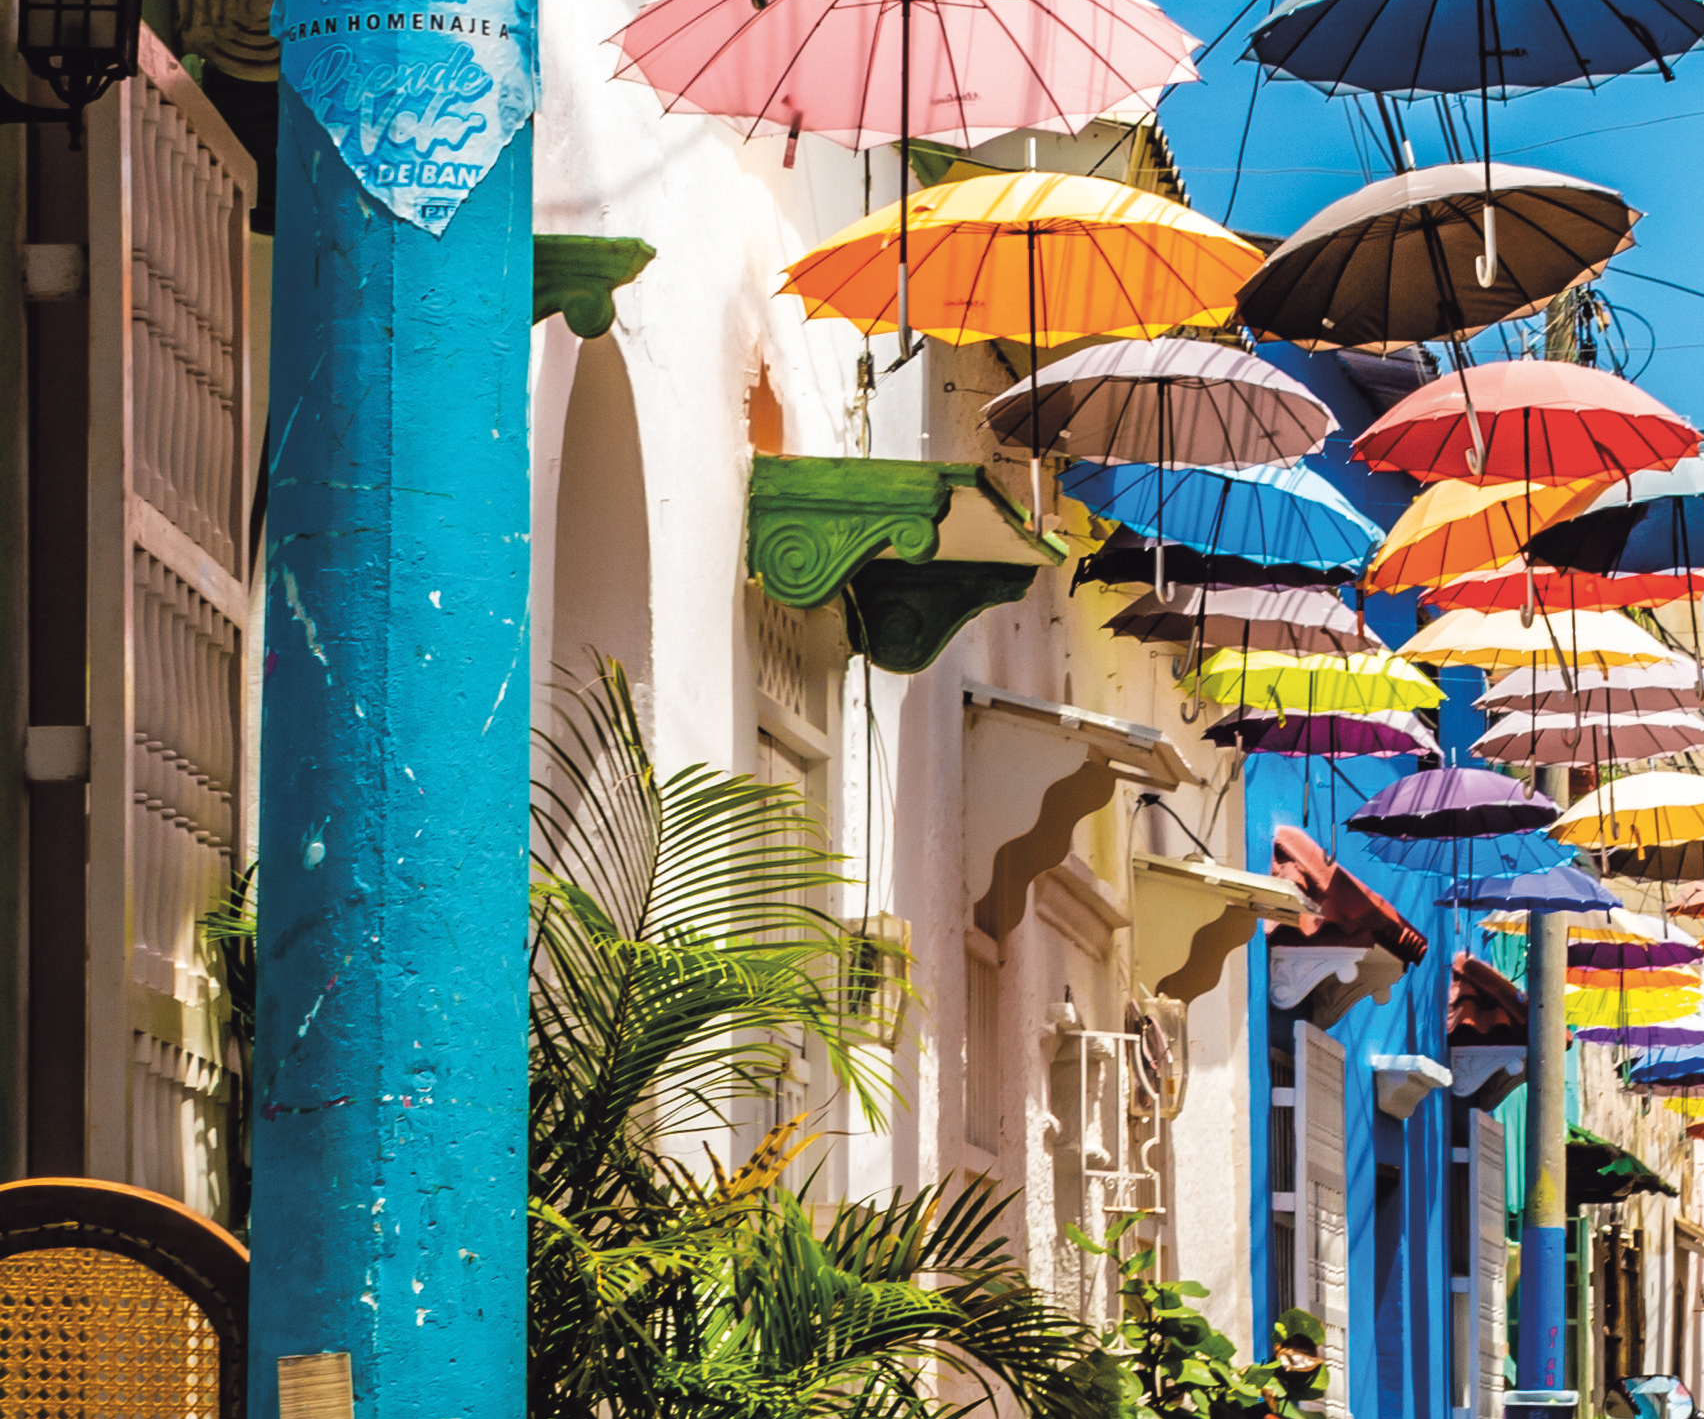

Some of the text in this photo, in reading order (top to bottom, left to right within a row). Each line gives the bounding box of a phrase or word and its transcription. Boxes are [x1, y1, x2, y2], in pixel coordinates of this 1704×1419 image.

[288, 13, 510, 42] GRAN HOMENAJE A
[303, 42, 494, 111] Prende
[377, 163, 413, 184] DE
[422, 164, 482, 188] BAN
